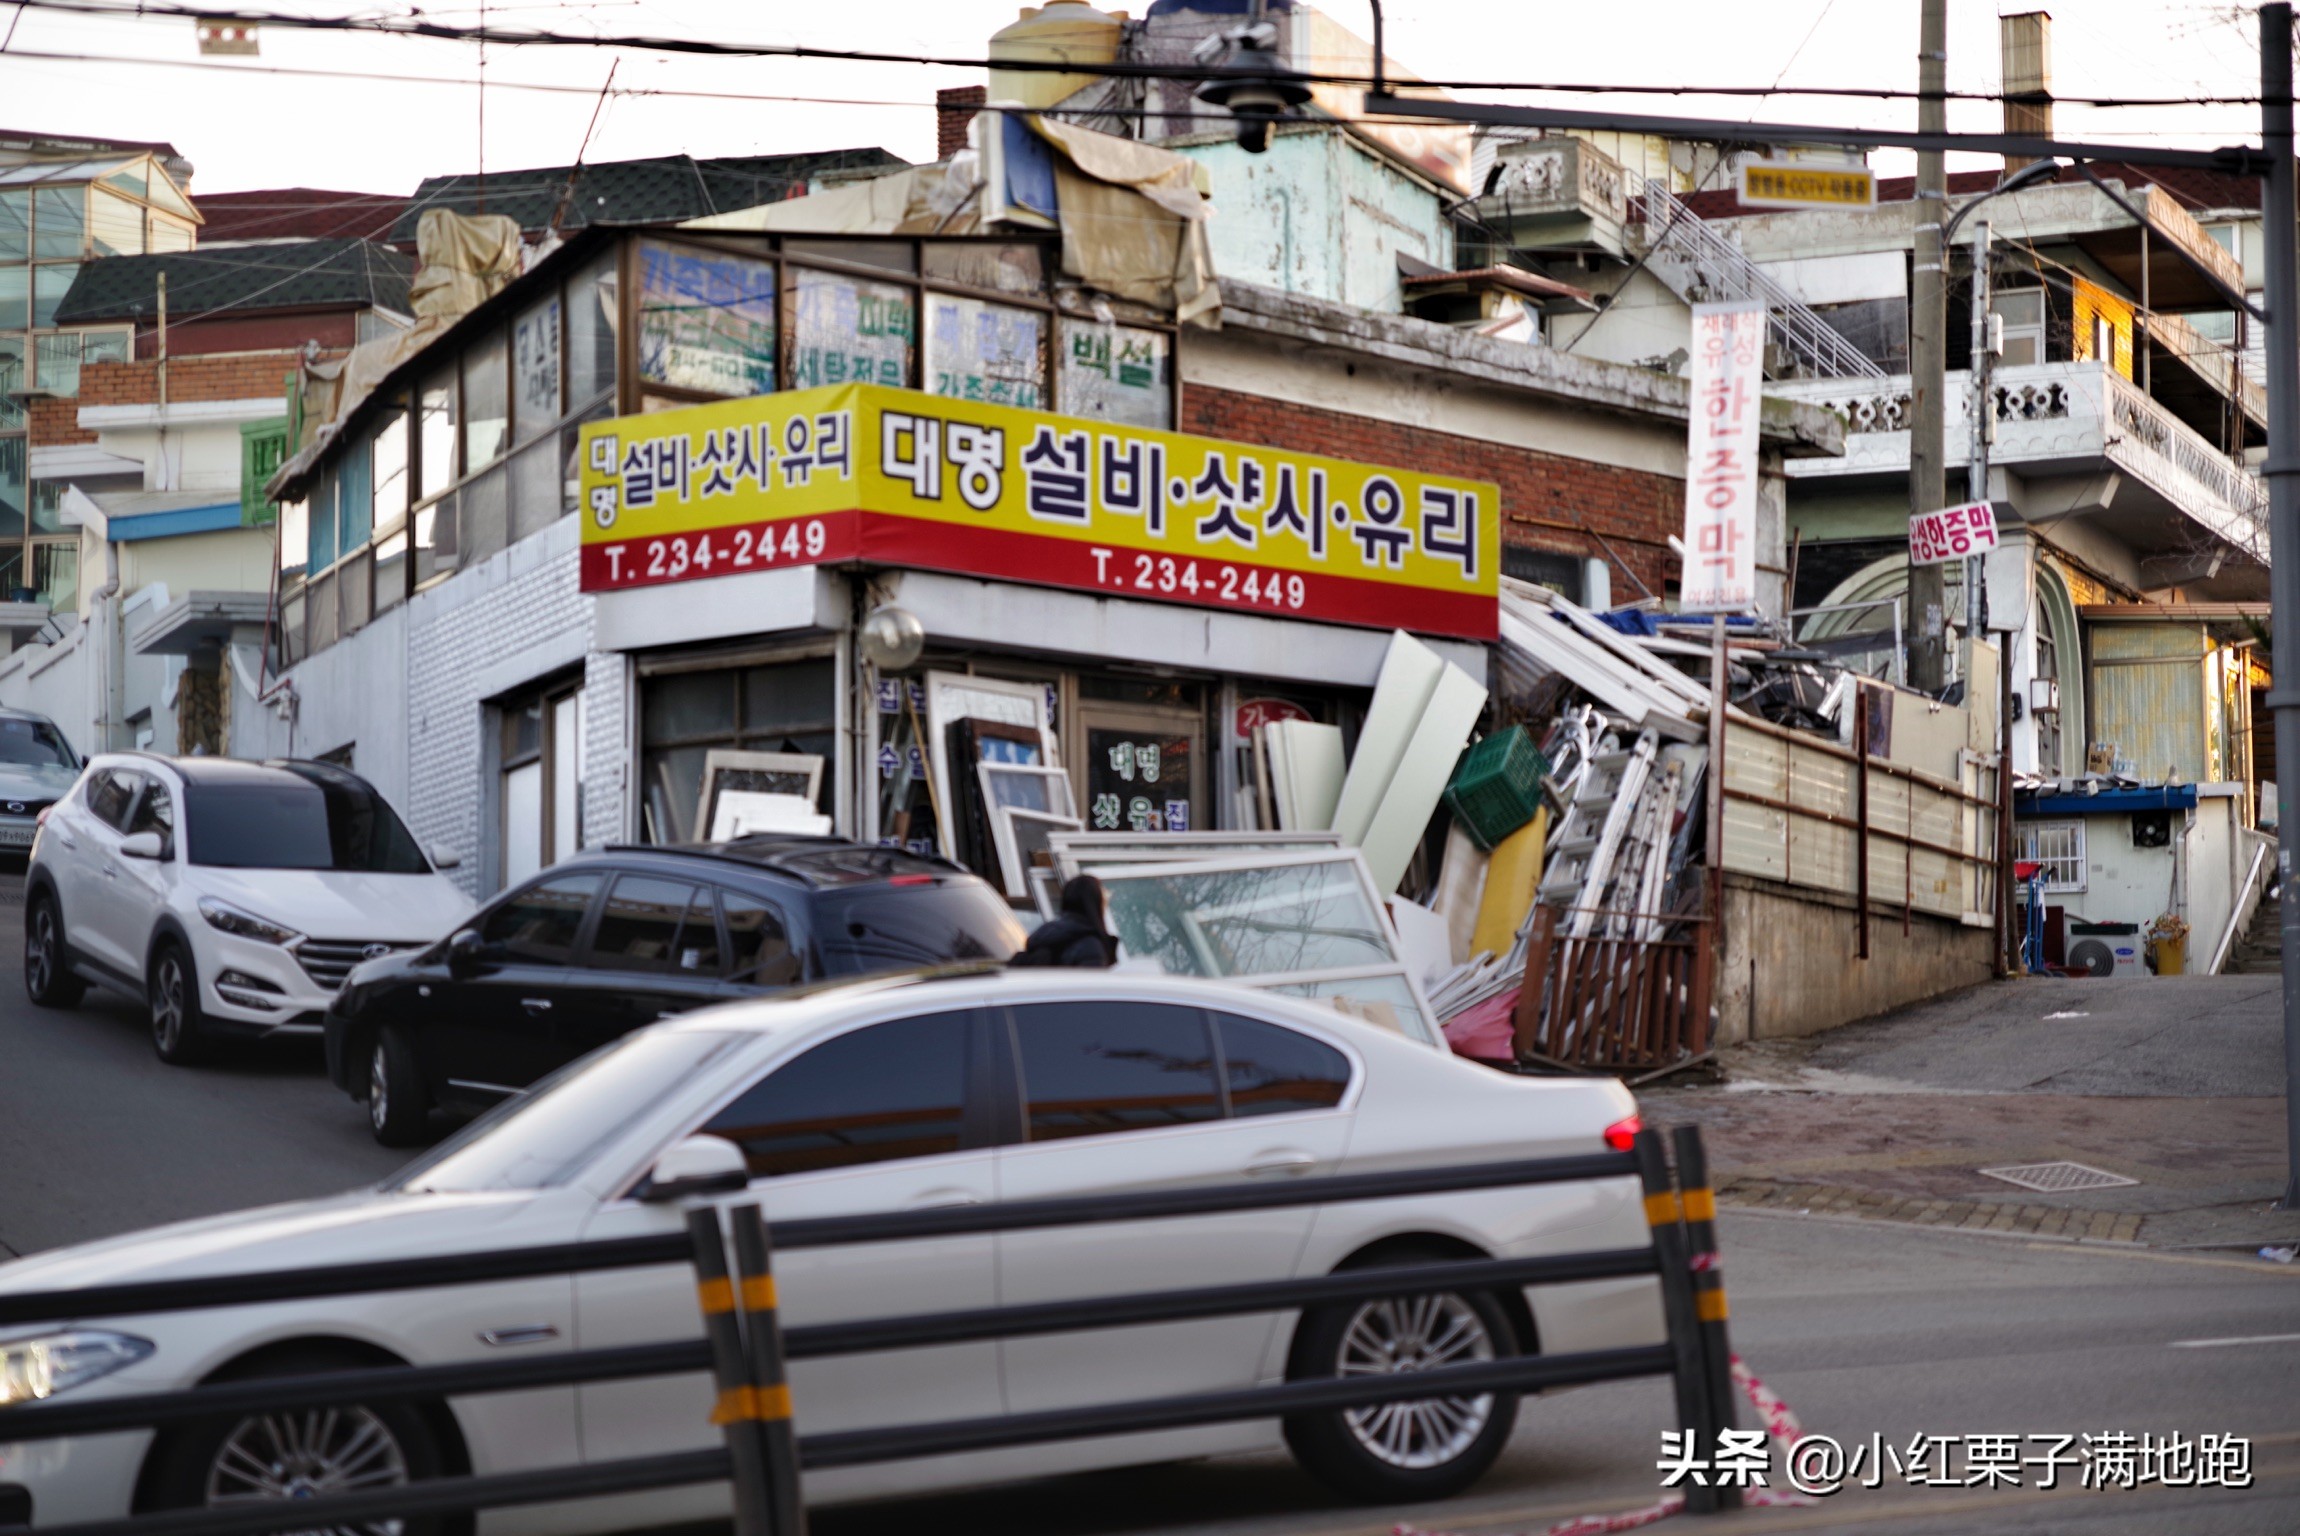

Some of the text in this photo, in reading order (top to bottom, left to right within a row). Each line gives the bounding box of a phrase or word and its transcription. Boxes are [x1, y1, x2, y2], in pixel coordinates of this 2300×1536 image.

[589, 434, 619, 529] 대명
[880, 410, 1005, 511] 대명
[1695, 375, 1752, 580] 한증막
[647, 520, 826, 577] 234-2449
[1135, 554, 1306, 608] 234-2449
[1108, 741, 1160, 783] 대명
